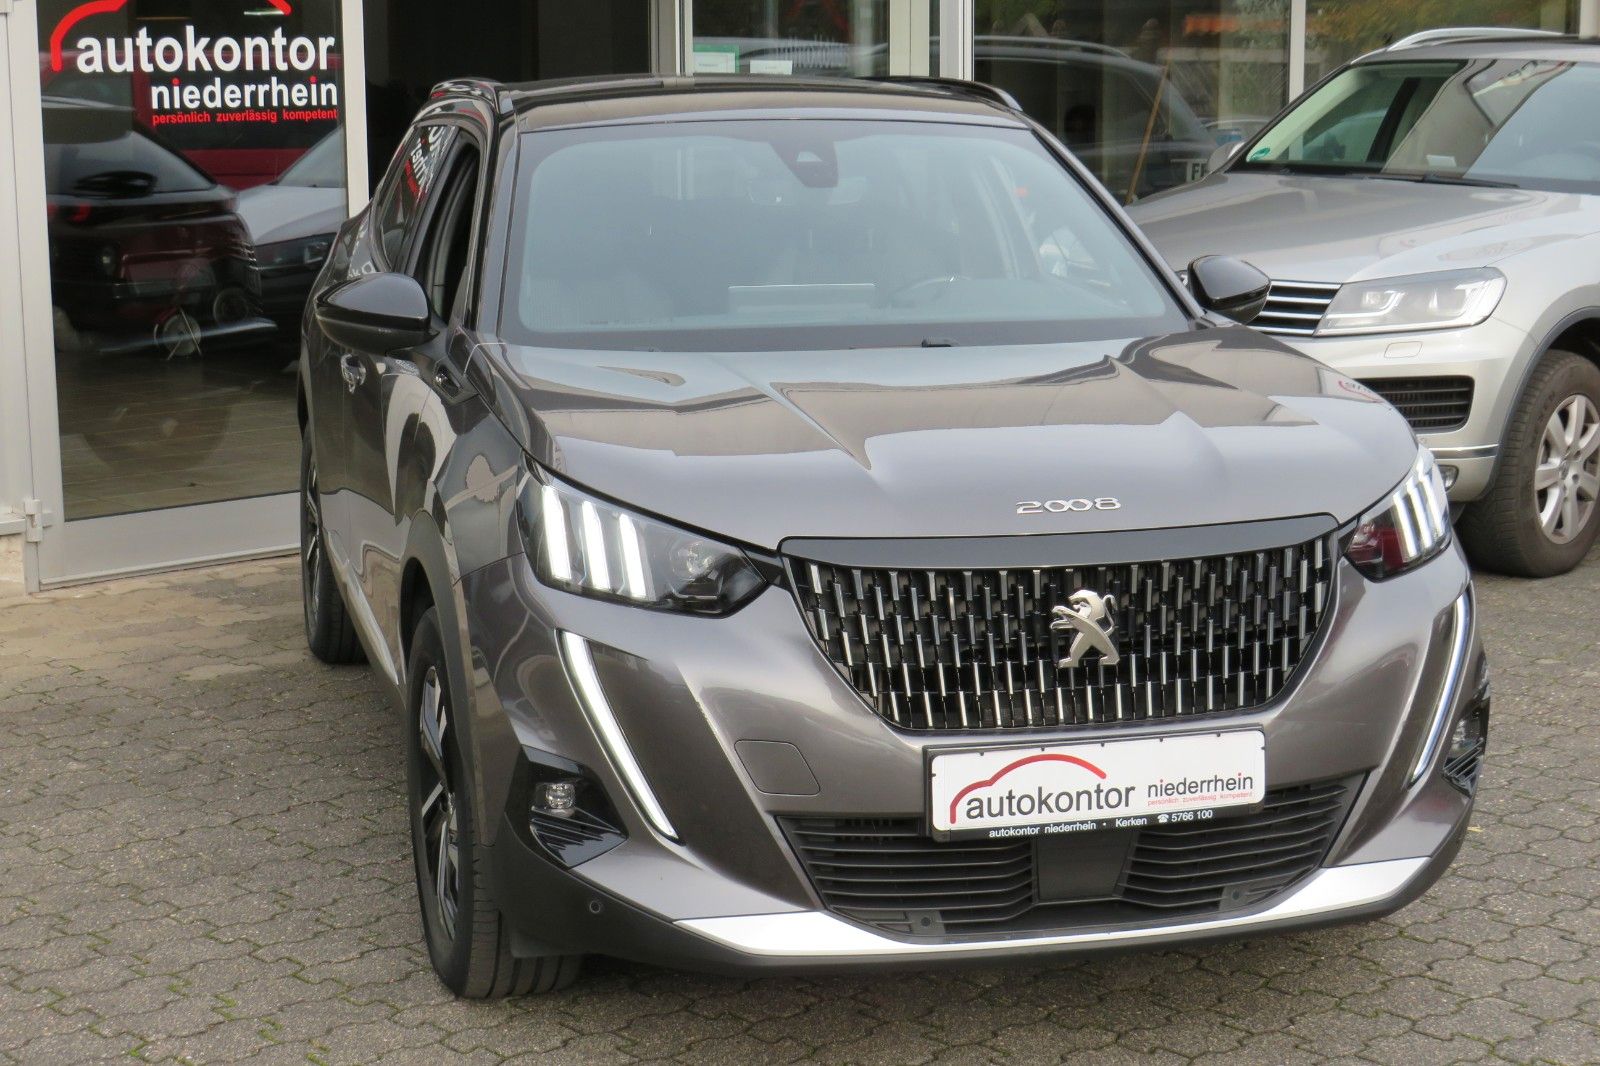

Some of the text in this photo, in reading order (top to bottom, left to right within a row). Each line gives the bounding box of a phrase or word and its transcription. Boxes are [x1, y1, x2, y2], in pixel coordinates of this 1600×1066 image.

[76, 25, 336, 73] autokontor
[150, 76, 338, 109] niederrhein
[152, 107, 339, 126] persönlich zuverlässig kompetent
[1016, 497, 1121, 514] 2008
[1147, 772, 1254, 798] niederrhein
[966, 782, 1136, 819] autokontor
[988, 809, 1213, 838] autokontor niederrhein Kerken 5766 100
